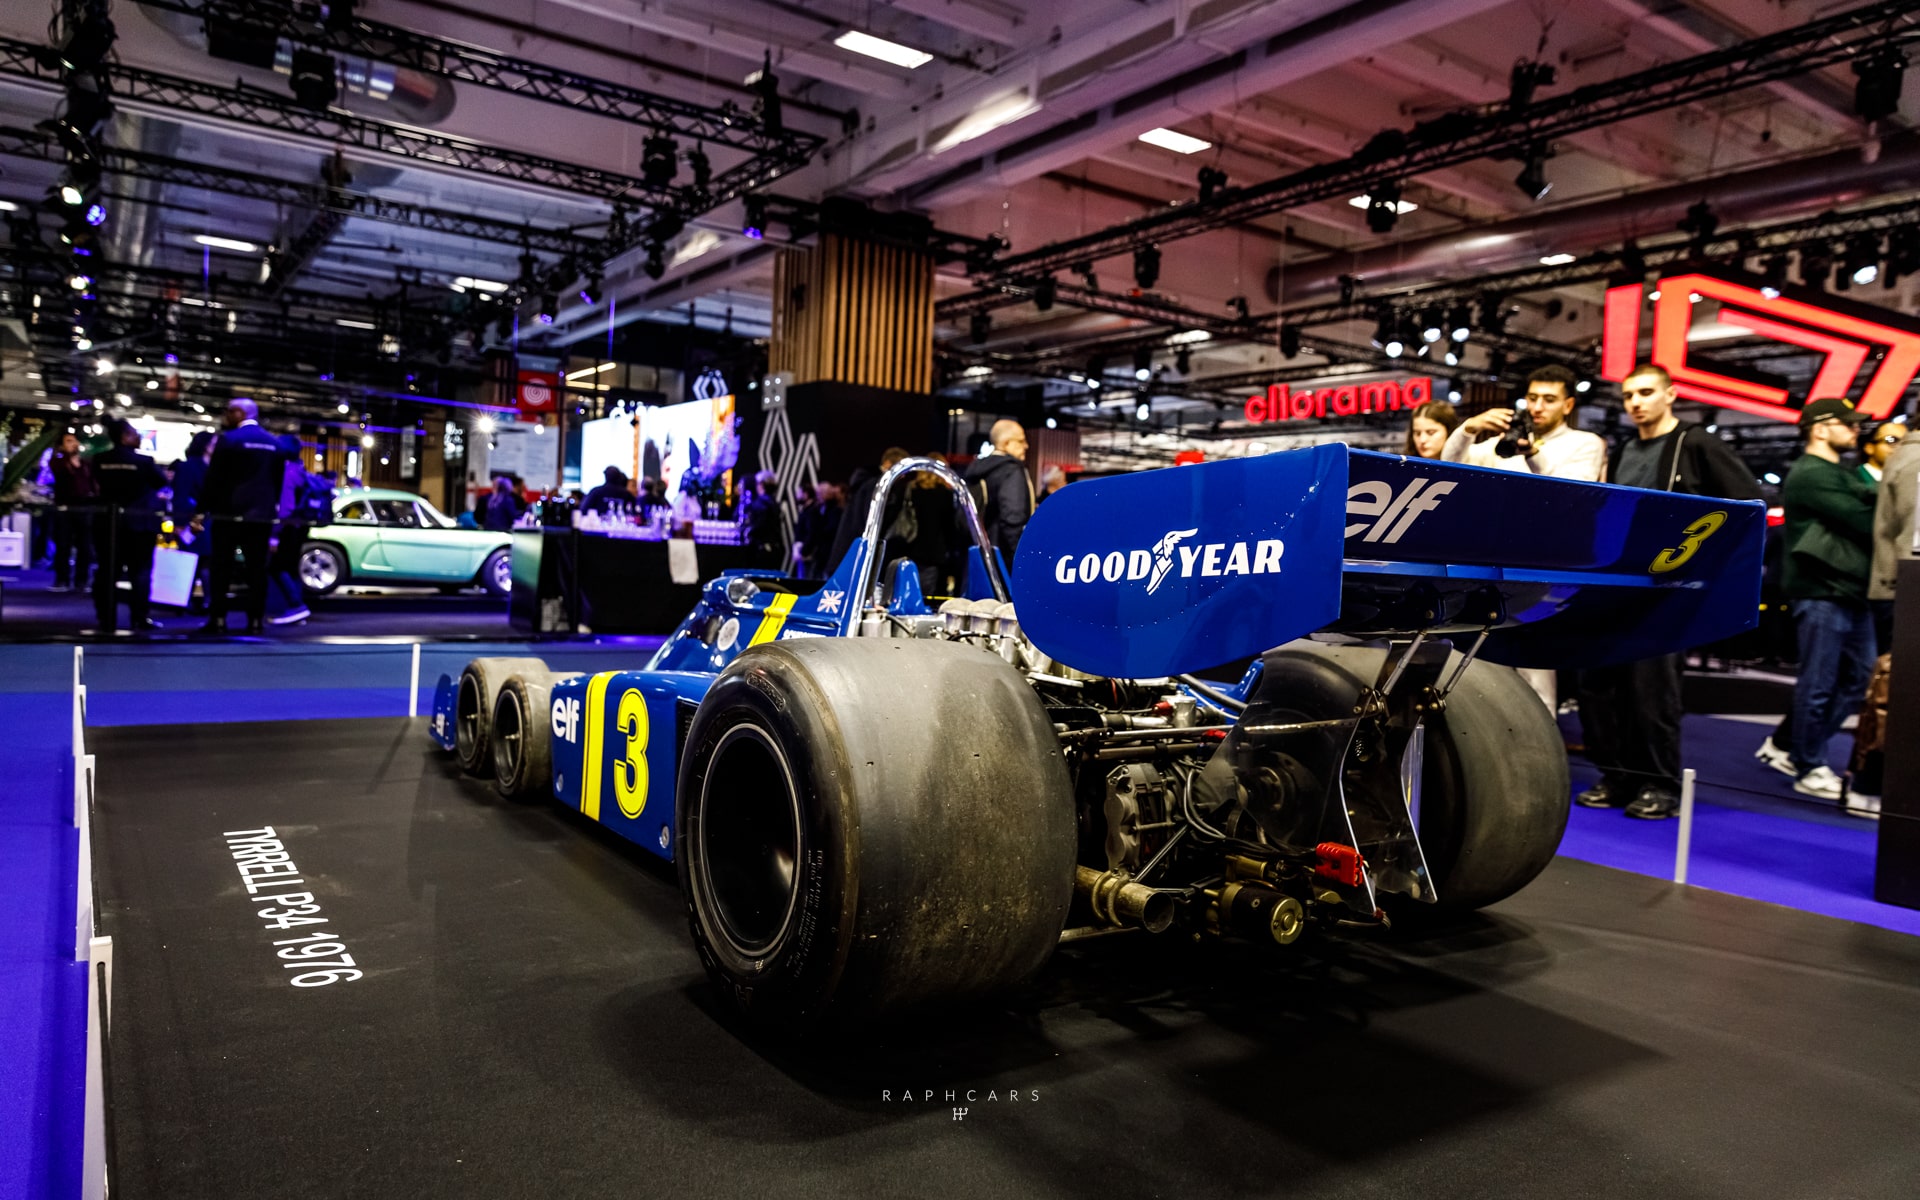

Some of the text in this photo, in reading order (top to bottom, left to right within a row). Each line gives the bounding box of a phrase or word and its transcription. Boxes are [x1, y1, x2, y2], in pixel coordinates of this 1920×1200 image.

[1244, 377, 1431, 424] cliorama
[1344, 477, 1459, 544] elf
[1648, 510, 1729, 574] 3
[551, 696, 580, 744] elf
[613, 687, 650, 820] 3
[223, 825, 364, 988] TYRRELL P34 1976
